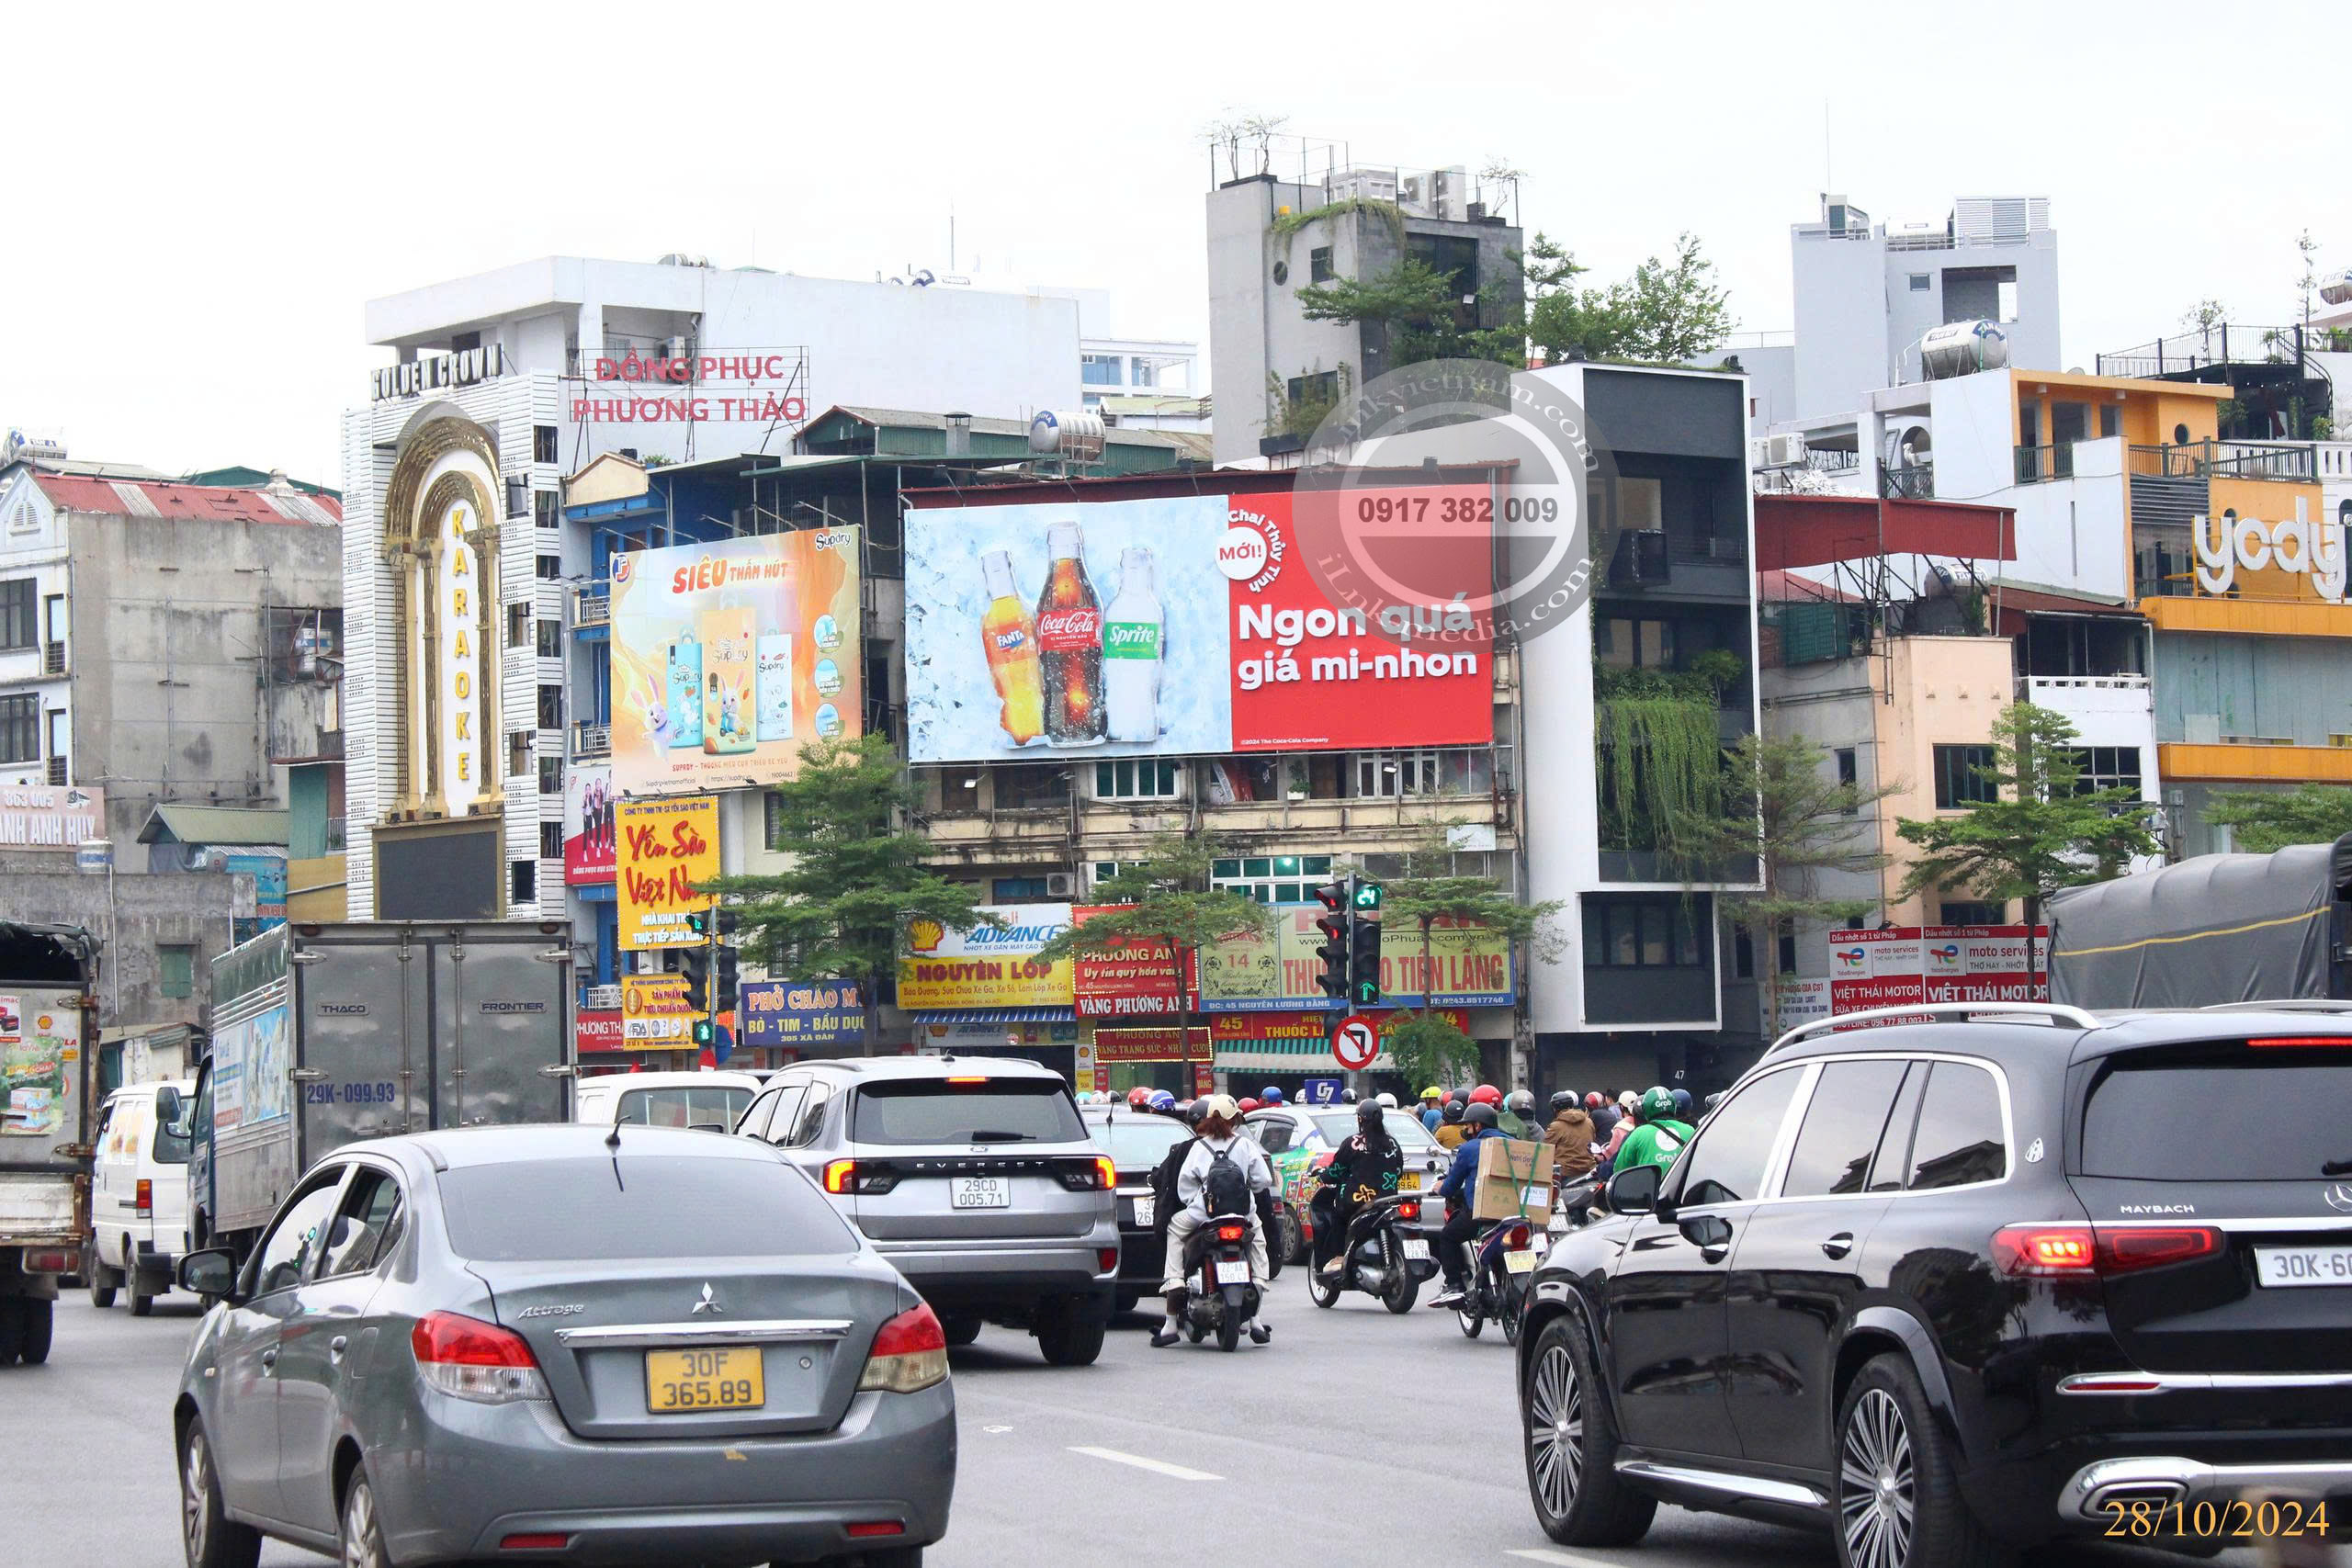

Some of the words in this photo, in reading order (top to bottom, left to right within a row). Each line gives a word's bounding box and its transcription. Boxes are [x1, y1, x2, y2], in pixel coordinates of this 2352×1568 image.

[371, 357, 434, 400] GOLDEN
[438, 344, 500, 387] CROWN
[700, 355, 785, 386] PHỤC
[573, 396, 709, 423] PHƯƠNG
[718, 391, 806, 422] THẢO
[816, 532, 852, 550] Supdry
[1264, 520, 1286, 562] Thủy
[1219, 542, 1262, 560] MỚI!
[673, 555, 728, 594] SIÊU
[729, 558, 761, 581] THẤM
[764, 558, 788, 579] HÚT
[1250, 565, 1281, 592] Tinh
[1041, 611, 1094, 636] Coca-Cola
[1238, 604, 1366, 646] Ngon
[1381, 592, 1474, 642] quá
[452, 510, 470, 781] KARAOKE
[1109, 626, 1154, 647] Sprite
[1238, 649, 1301, 690] giá
[1311, 648, 1477, 681] mi-nhon
[626, 824, 668, 862] Yến
[626, 866, 665, 908] Việt
[677, 912, 689, 924] TH
[633, 931, 652, 945] TRỰC
[653, 928, 671, 943] TIẾP
[673, 927, 685, 942] SẢN
[965, 925, 1062, 943] ADVANCE
[1974, 929, 1990, 937] Pháp
[1874, 946, 1891, 954] moto
[1893, 945, 1919, 953] services
[1969, 946, 1997, 957] moto
[2000, 944, 2044, 957] servies
[1228, 954, 1250, 968] 14
[1986, 962, 1999, 970] HAY
[1101, 966, 1114, 977] tín
[1116, 965, 1136, 979] quý
[1283, 959, 1329, 995] THU
[748, 984, 785, 1011] PHỞ
[1834, 985, 1857, 1001] VIỆT
[1859, 984, 1883, 998] THÁI
[1885, 985, 1921, 998] MOTOR
[1963, 981, 1997, 1001] THÁI
[322, 1004, 366, 1014] THACO
[481, 1002, 545, 1011] FRONTIER
[1080, 995, 1112, 1014] VÀNG
[1115, 994, 1164, 1013] PHƯƠNG
[1851, 1005, 1860, 1014] XE
[748, 1016, 765, 1033] BÒ
[777, 1018, 800, 1032] TIM
[1220, 1016, 1242, 1030] 45
[1265, 1021, 1309, 1038] THUỐC
[781, 1034, 798, 1043] 305
[1119, 1044, 1145, 1055] TRANG
[1675, 1070, 1685, 1079] 47
[306, 1082, 395, 1104] 29K-099.93
[1317, 1082, 1334, 1101] G7
[1655, 1099, 1672, 1108] Grab
[965, 1179, 997, 1192] 29CD
[959, 1194, 1002, 1207] 005.71
[2120, 1205, 2195, 1213] MAYBACH
[518, 1303, 584, 1319] Attrage
[682, 1351, 728, 1376] 30F
[662, 1380, 752, 1406] 365.89
